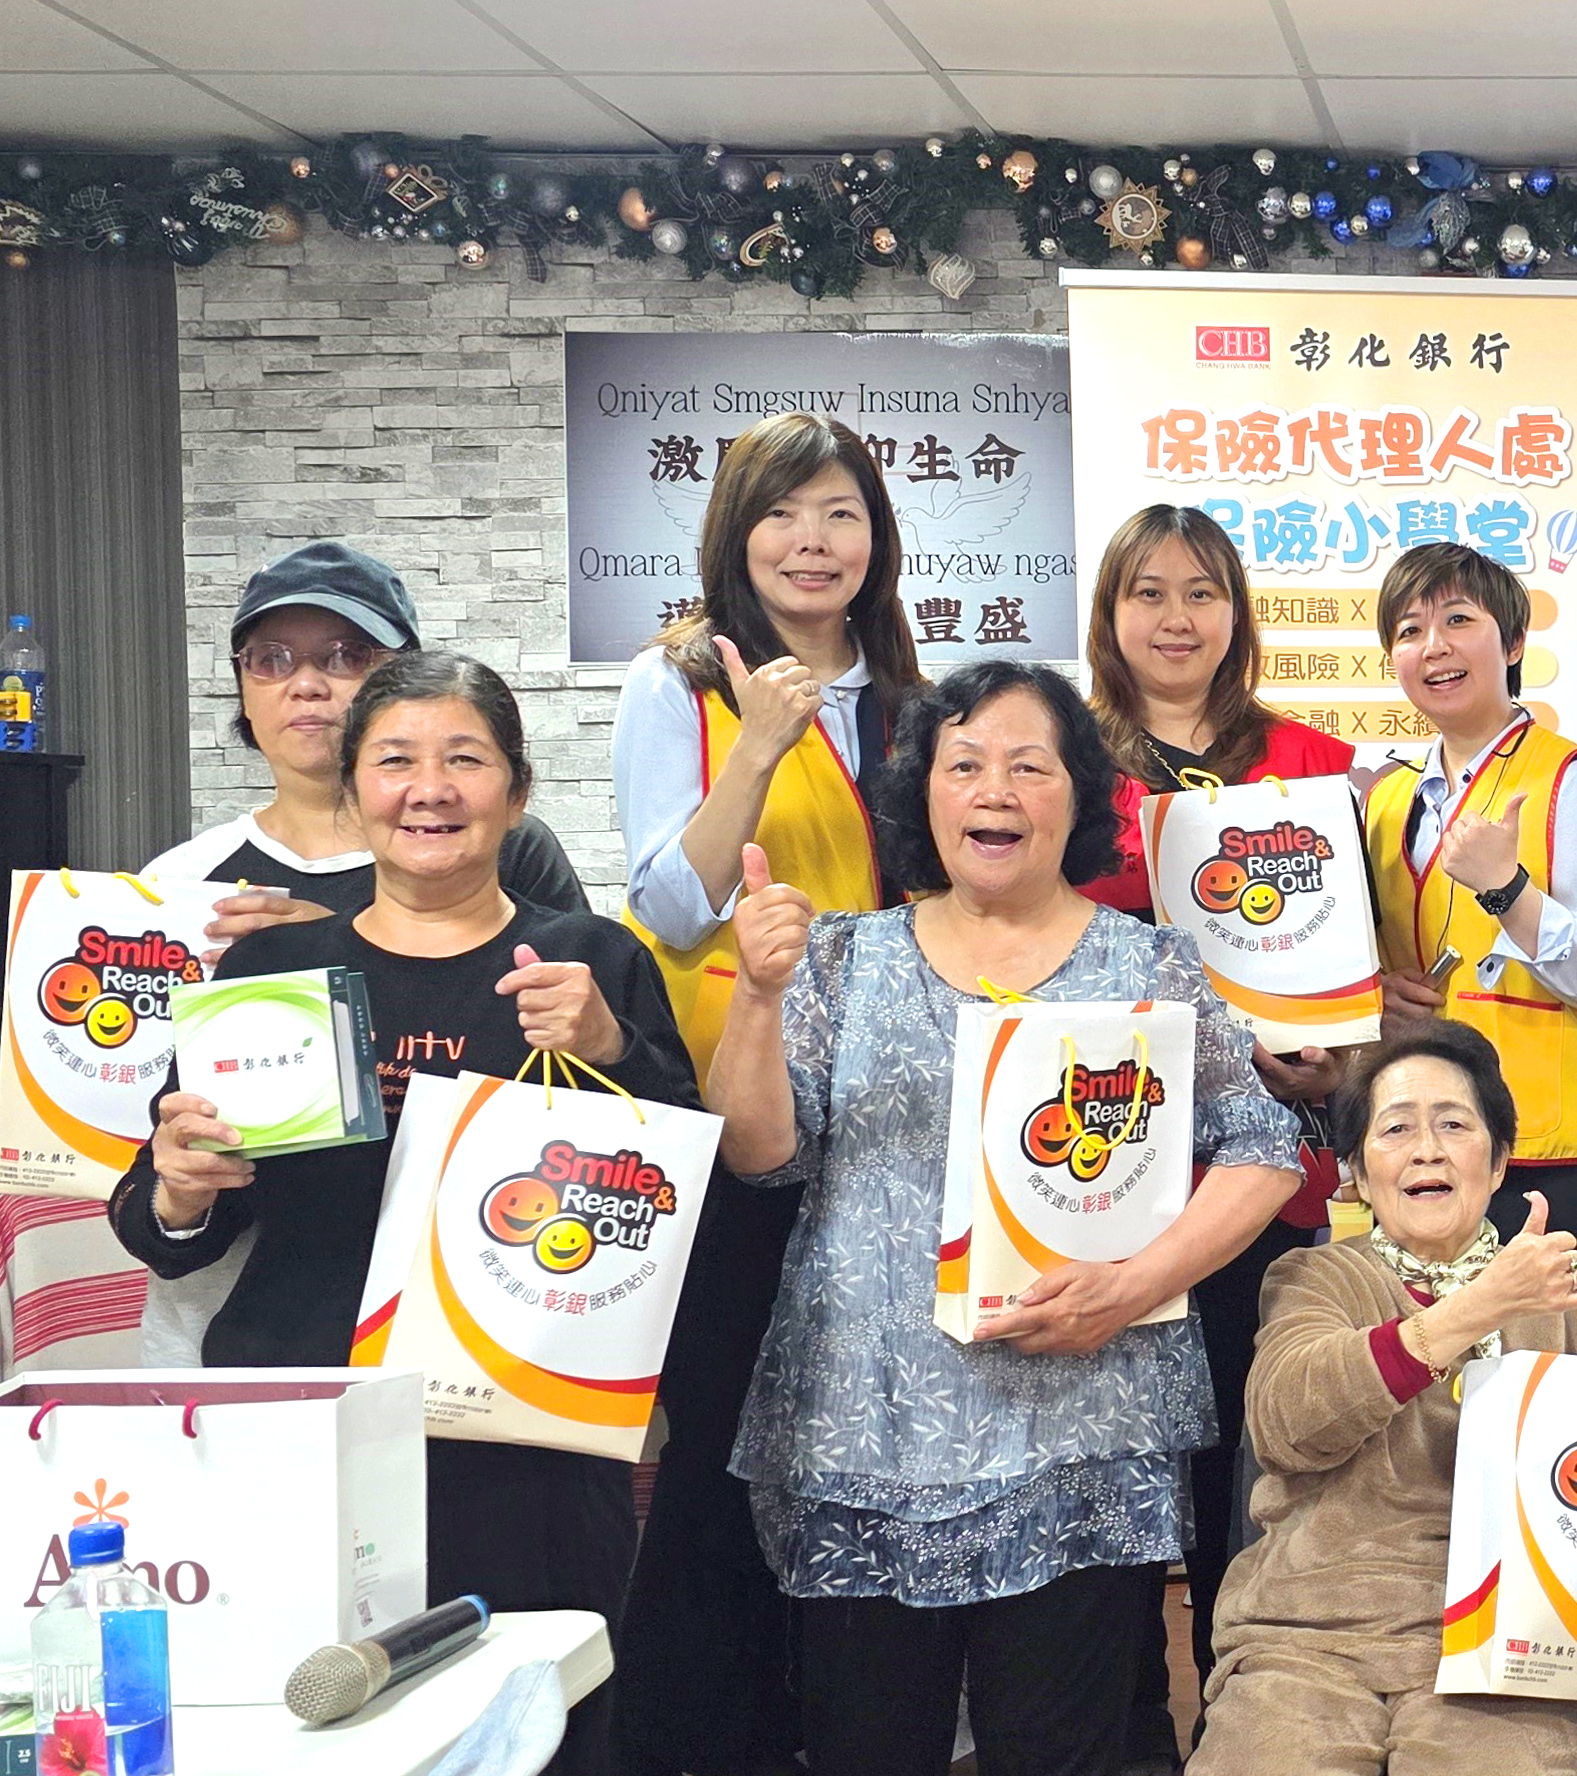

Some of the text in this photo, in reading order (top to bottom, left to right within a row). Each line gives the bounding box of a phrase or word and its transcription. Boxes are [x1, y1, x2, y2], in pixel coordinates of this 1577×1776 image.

[1198, 329, 1269, 358] CHB
[1290, 327, 1510, 373] 彰化銀行
[597, 383, 701, 421] Qniyat
[713, 383, 846, 419] Smgsuw
[858, 383, 961, 414] Insuna
[1141, 408, 1567, 480] 保險代理人處
[579, 546, 682, 582] Qmara
[1221, 824, 1315, 858] Smile
[1247, 852, 1318, 876] Reach
[1277, 872, 1322, 893] Out
[80, 930, 186, 970] Smile
[102, 966, 182, 994] Reach
[133, 995, 172, 1019] Ou
[541, 1145, 660, 1194] Smile
[561, 1184, 654, 1223] Reach
[593, 1218, 650, 1248] Out
[36, 1663, 92, 1713] FIJI
